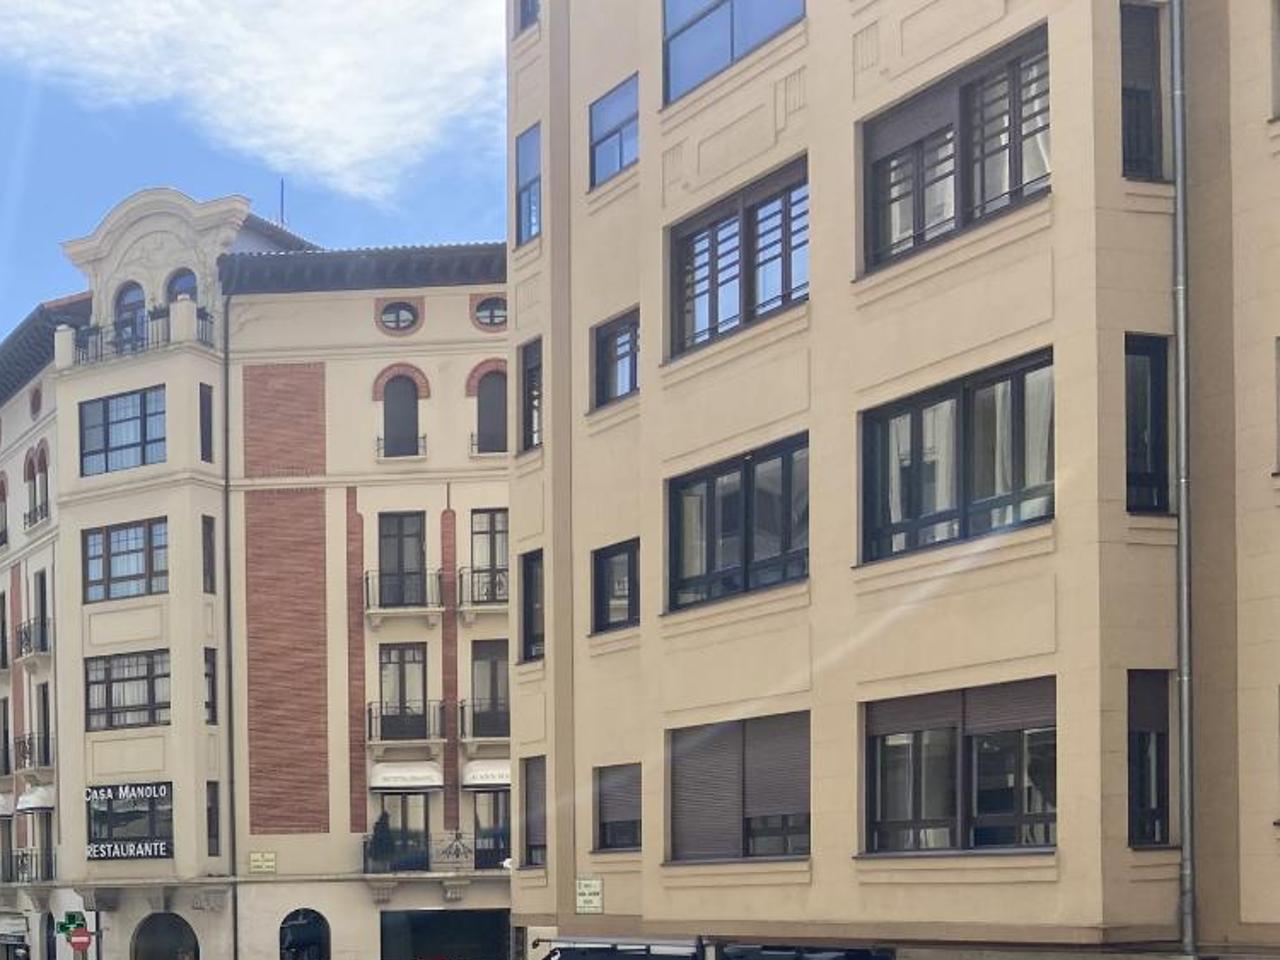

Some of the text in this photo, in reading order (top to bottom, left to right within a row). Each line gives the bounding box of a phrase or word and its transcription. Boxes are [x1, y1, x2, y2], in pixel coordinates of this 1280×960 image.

[83, 785, 167, 802] CASA MANOLO
[86, 842, 167, 858] RESTAURANTE
